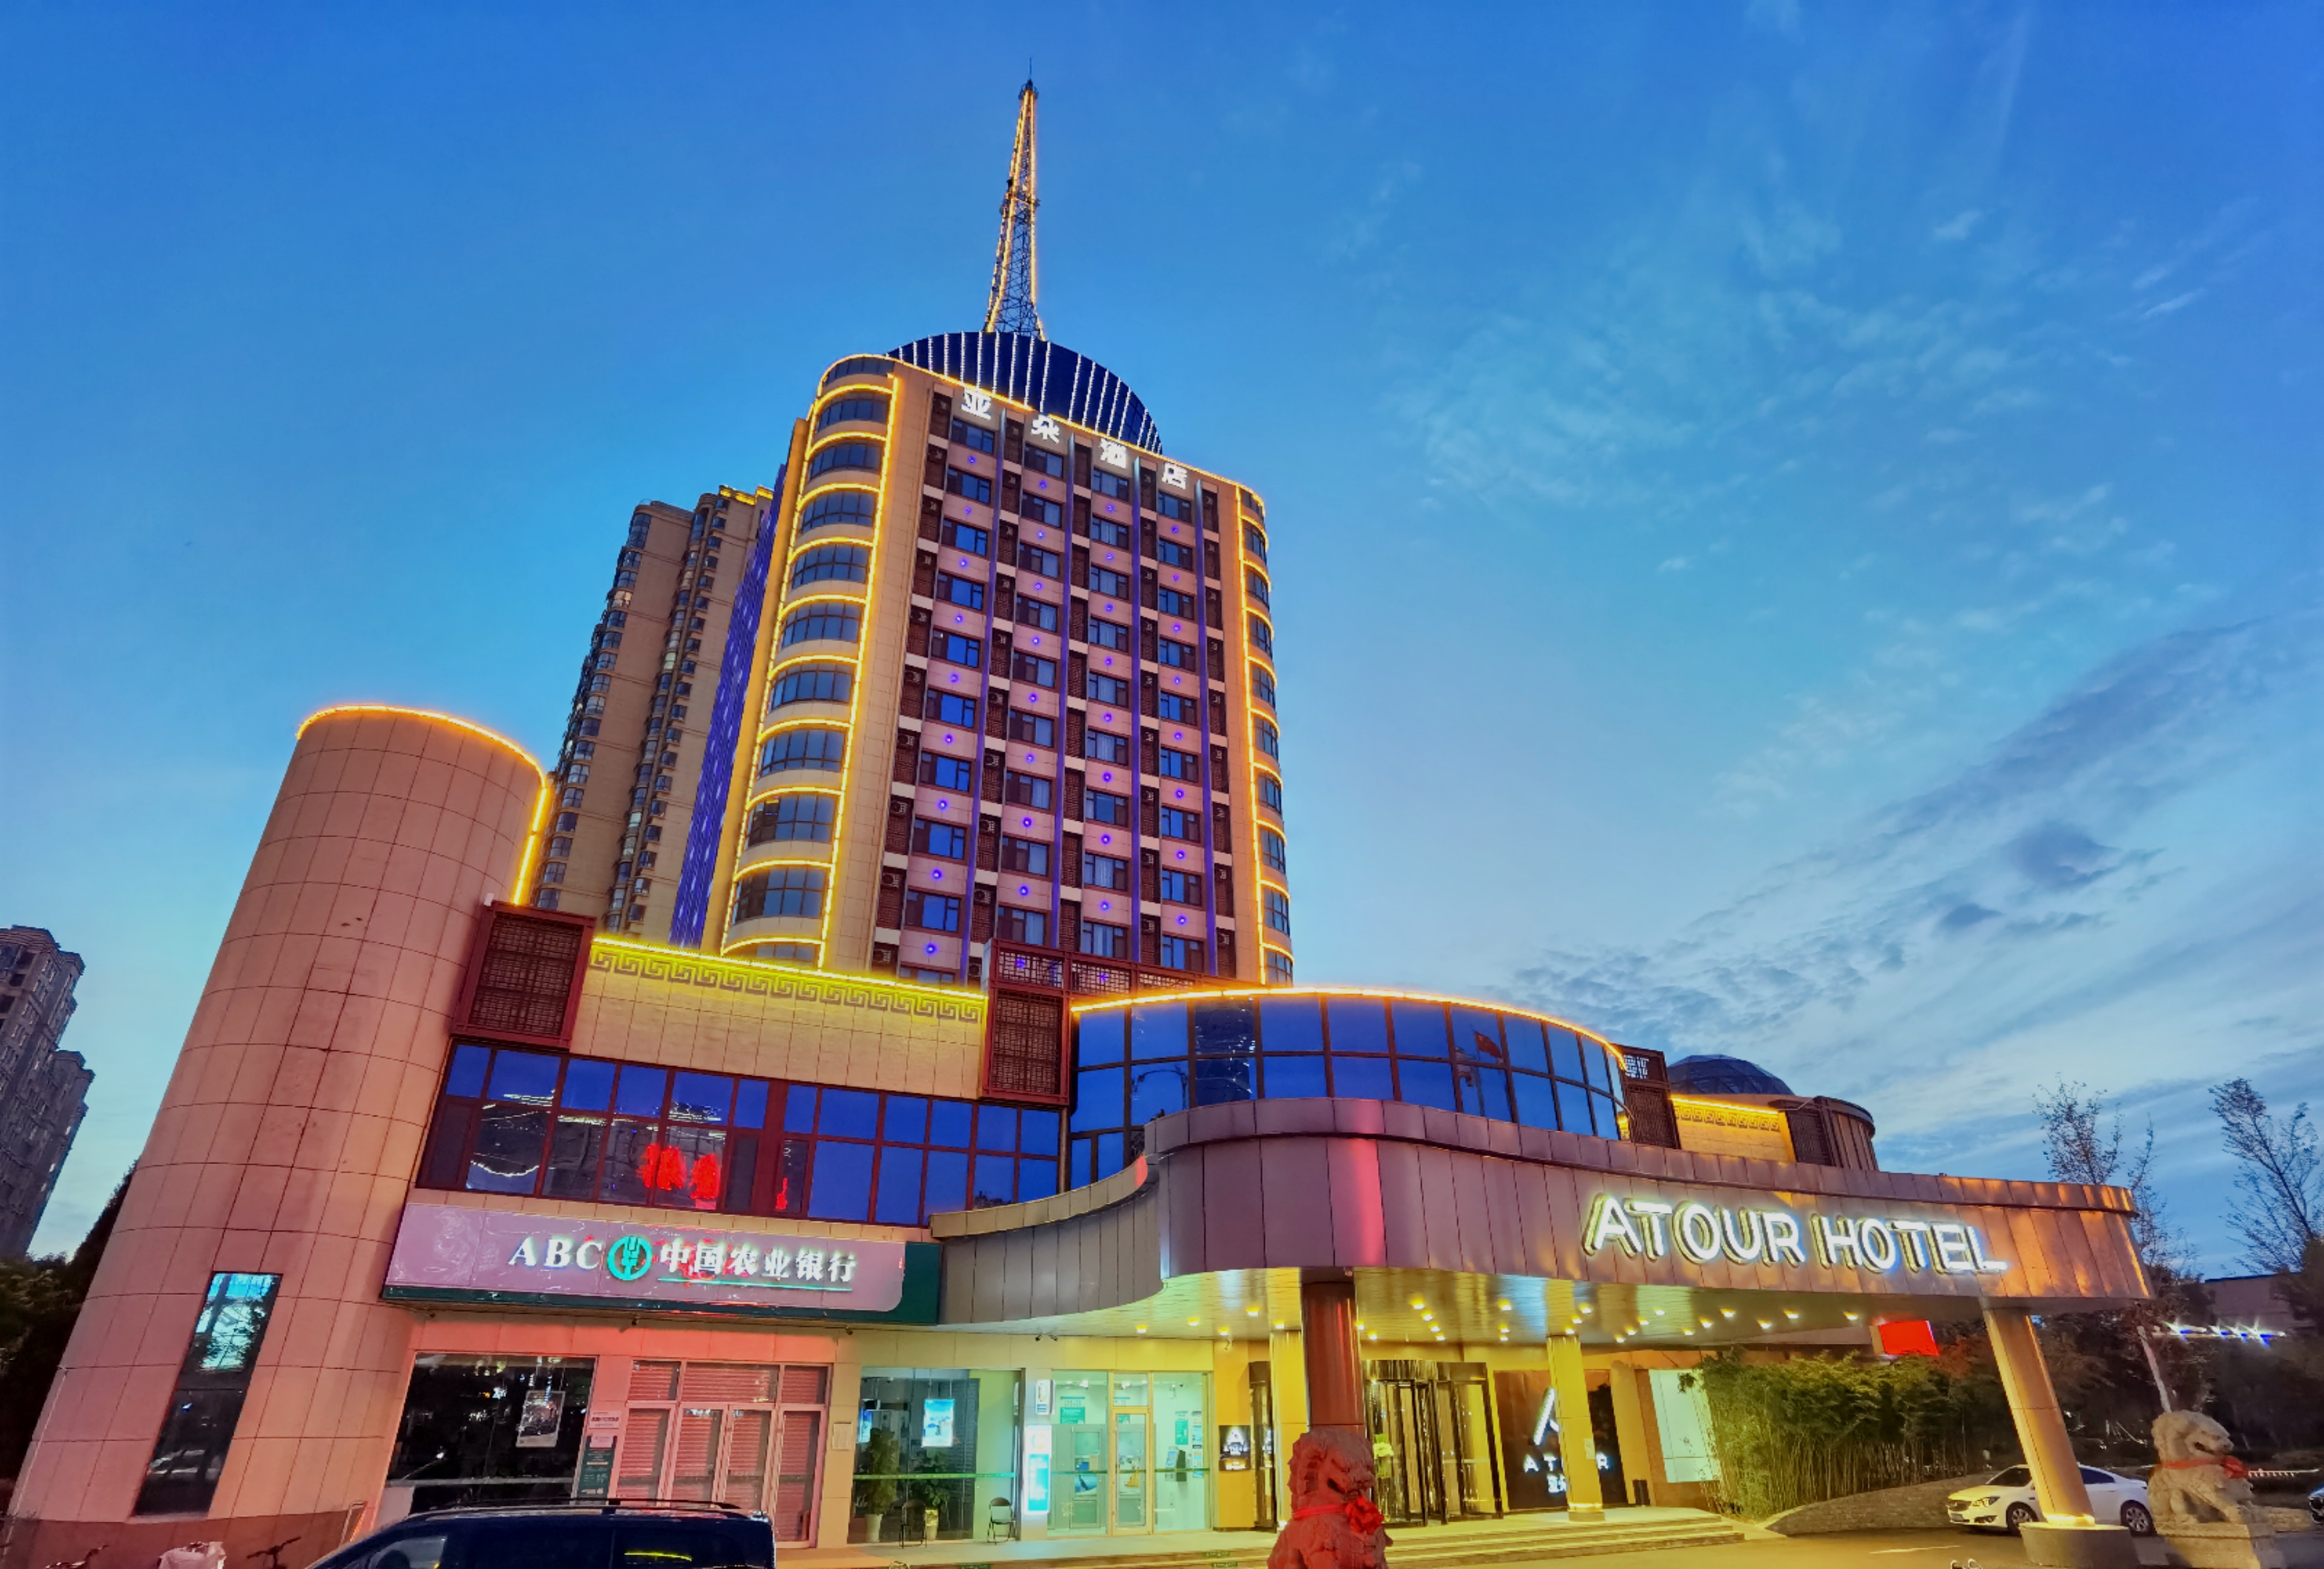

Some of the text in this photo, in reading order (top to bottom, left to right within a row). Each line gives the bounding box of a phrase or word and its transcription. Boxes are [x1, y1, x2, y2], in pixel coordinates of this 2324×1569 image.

[961, 387, 1187, 489] 亚朵酒店
[508, 1236, 856, 1282] ABC 中国农业银行
[1583, 1194, 2008, 1272] ATOUR HOTEL
[1523, 1454, 1609, 1473] ATR
